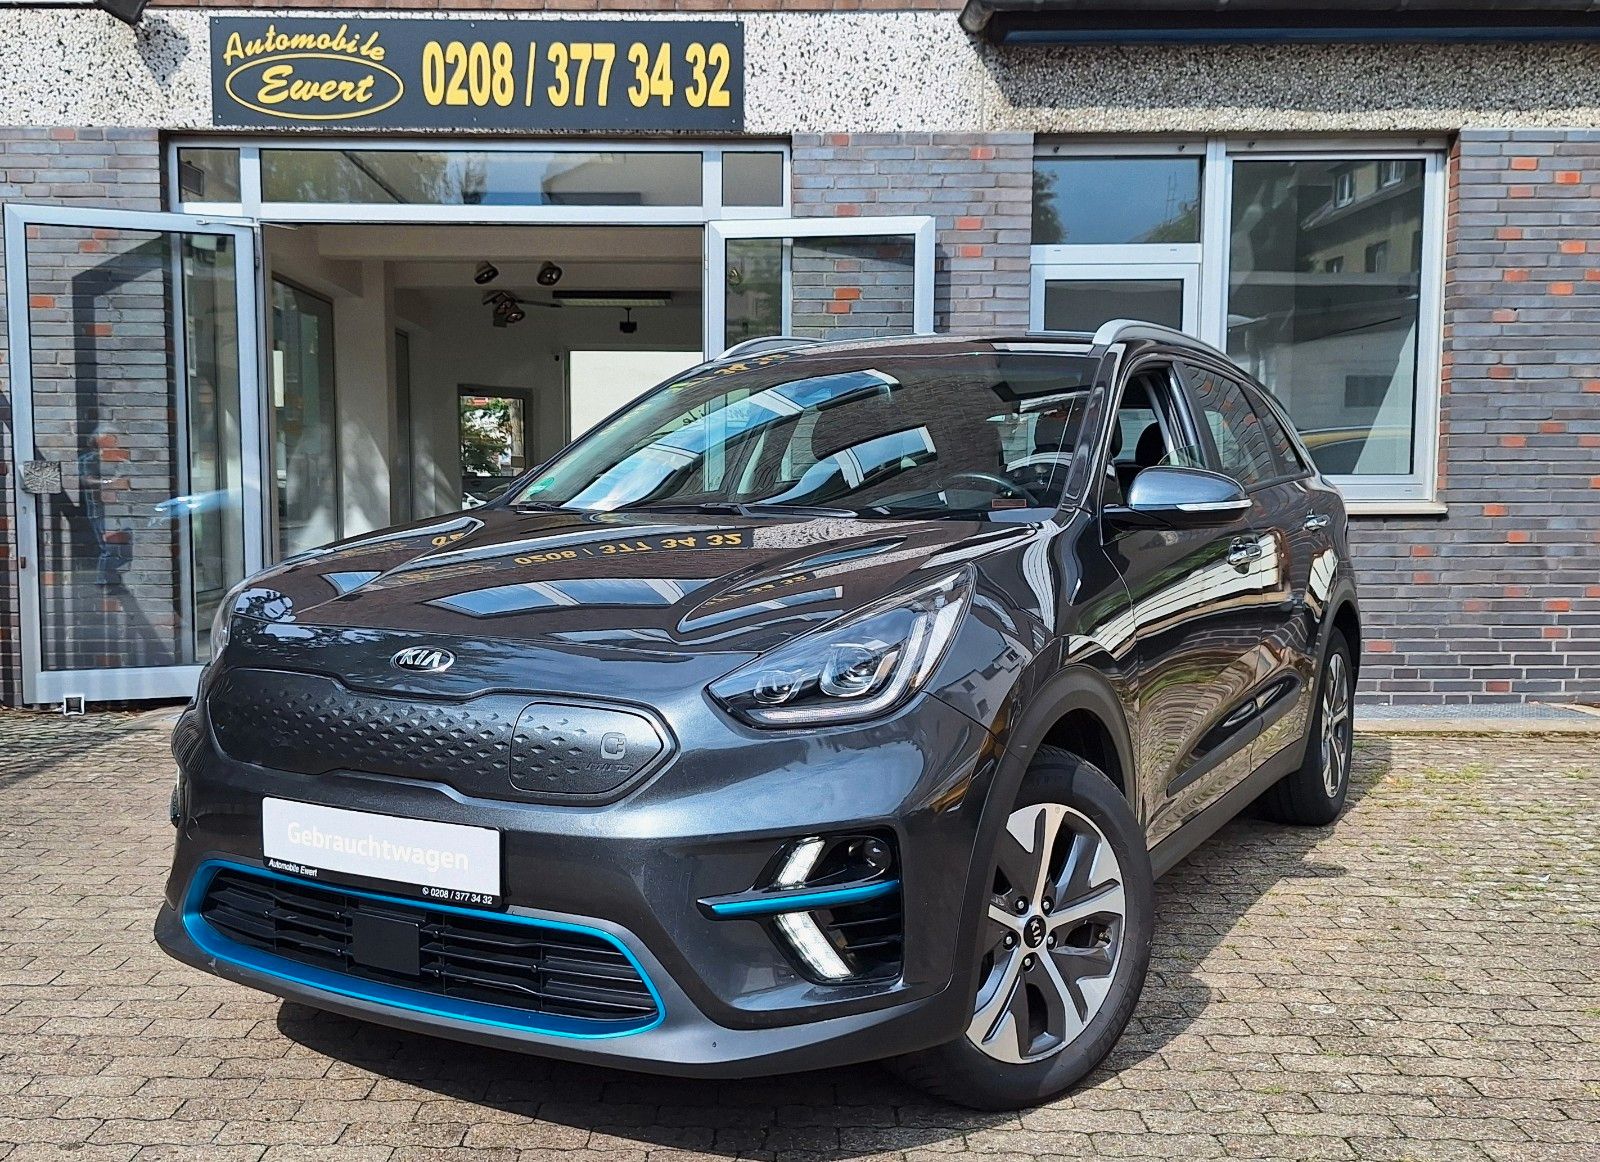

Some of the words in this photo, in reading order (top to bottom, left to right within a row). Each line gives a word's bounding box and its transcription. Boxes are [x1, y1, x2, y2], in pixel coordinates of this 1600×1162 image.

[222, 23, 386, 67] Automobile
[257, 64, 375, 104] Ewert
[422, 40, 514, 106] 0208
[525, 41, 537, 107] /
[547, 42, 616, 107] 377
[627, 42, 674, 107] 34
[684, 42, 731, 108] 32
[398, 648, 443, 668] KIA
[287, 821, 469, 873] Gebrauchtwagen
[268, 858, 300, 873] Automobile
[300, 865, 318, 877] Ewert
[430, 887, 449, 899] 0208
[455, 891, 470, 902] 377
[471, 893, 481, 903] 34
[482, 895, 493, 905] 32
[1030, 918, 1042, 945] KIA
